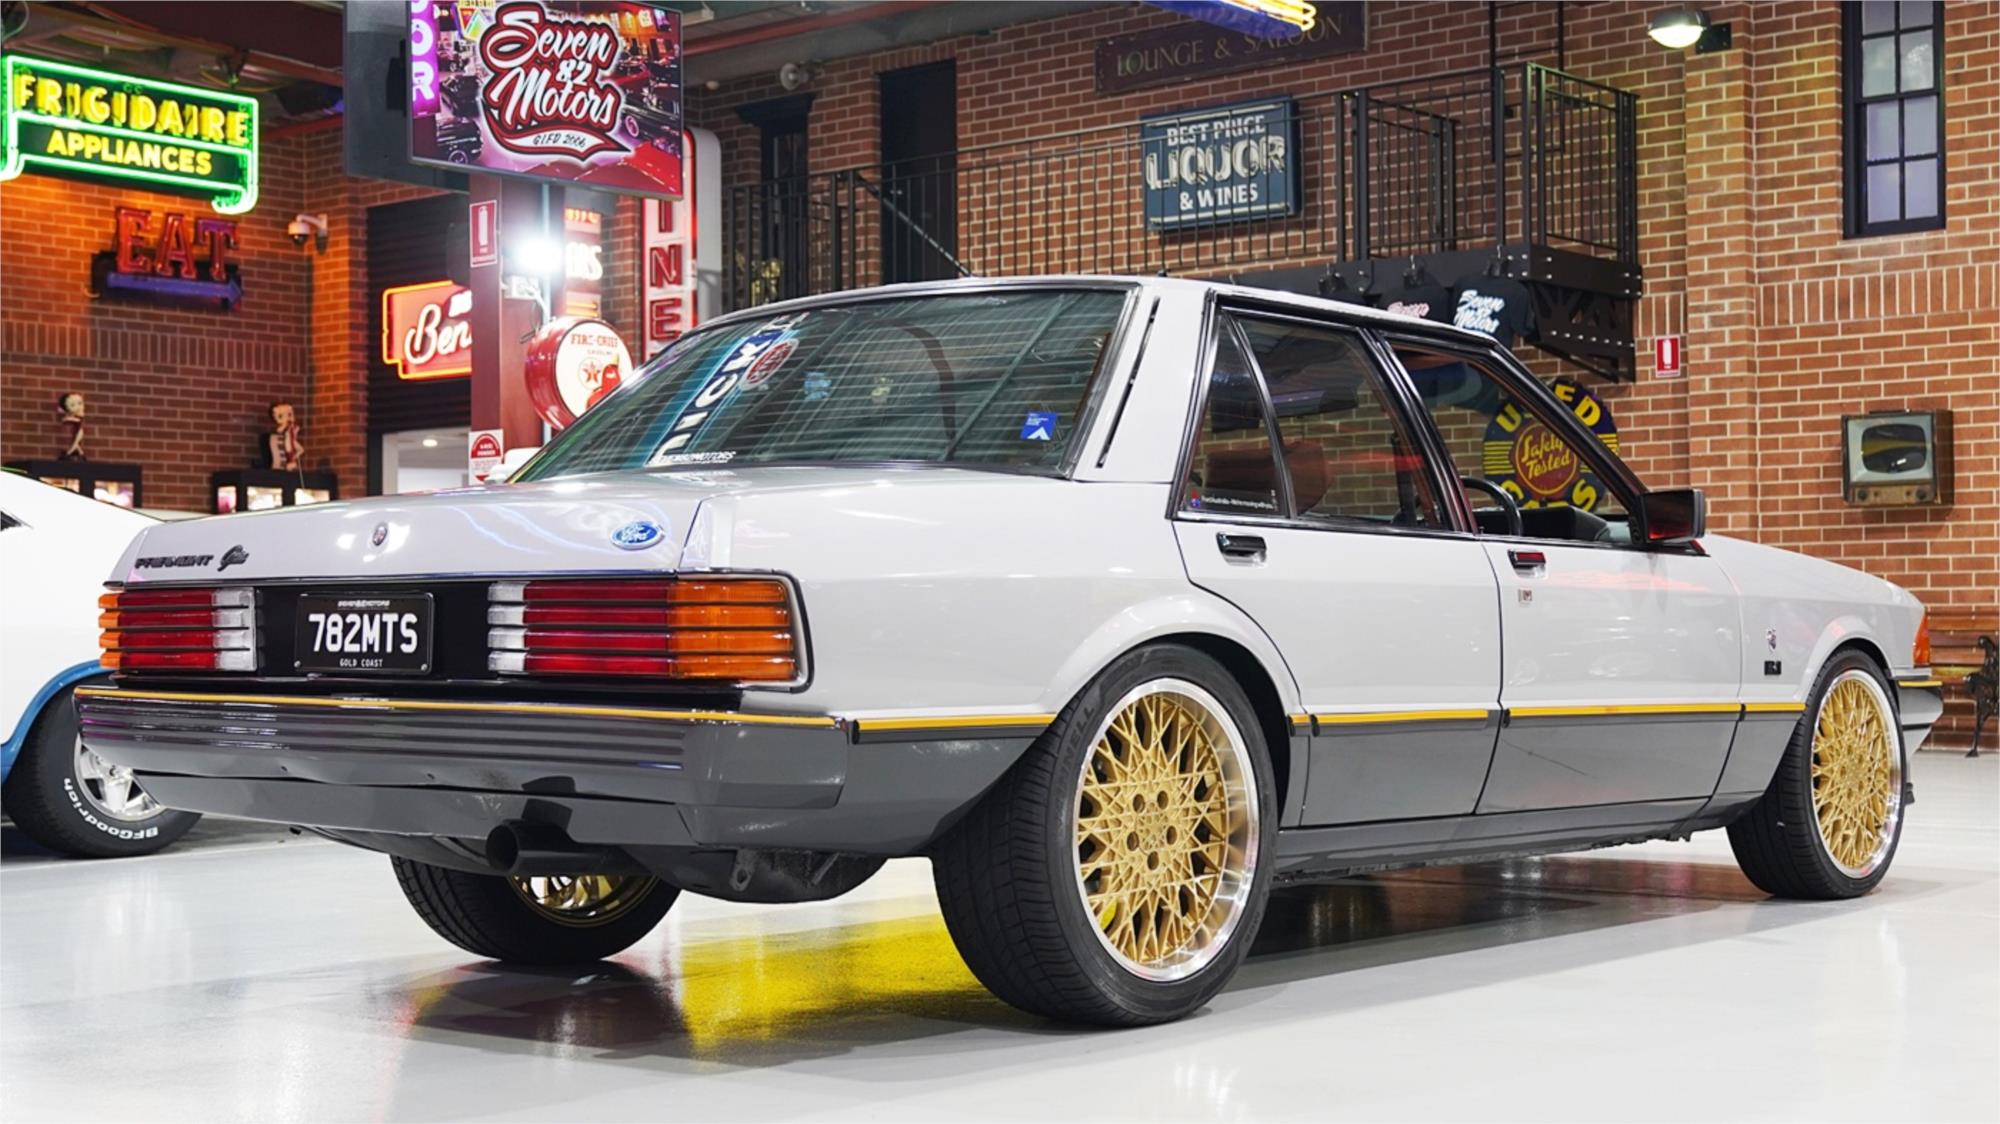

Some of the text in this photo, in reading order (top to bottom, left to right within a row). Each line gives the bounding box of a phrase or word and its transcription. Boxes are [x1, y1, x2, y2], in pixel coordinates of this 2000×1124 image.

[487, 10, 613, 69] Seven
[1117, 41, 1204, 77] LOUNGE
[1214, 38, 1231, 60] &
[555, 59, 592, 86] 82
[14, 74, 250, 147] FRIGIDAIRE
[490, 66, 616, 126] Motors
[1167, 114, 1266, 147] BEST PRICE
[47, 130, 213, 175] APPLIANCES
[1146, 135, 1286, 190] LIQUOR
[1179, 182, 1258, 211] & WINES
[115, 207, 241, 281] EAT
[649, 200, 683, 360] INE
[1521, 431, 1565, 463] Safety
[1525, 448, 1570, 481] Tested
[308, 613, 418, 654] 782MTS
[339, 659, 384, 668] GOLD COAST
[63, 777, 159, 840] BFGoodrich
